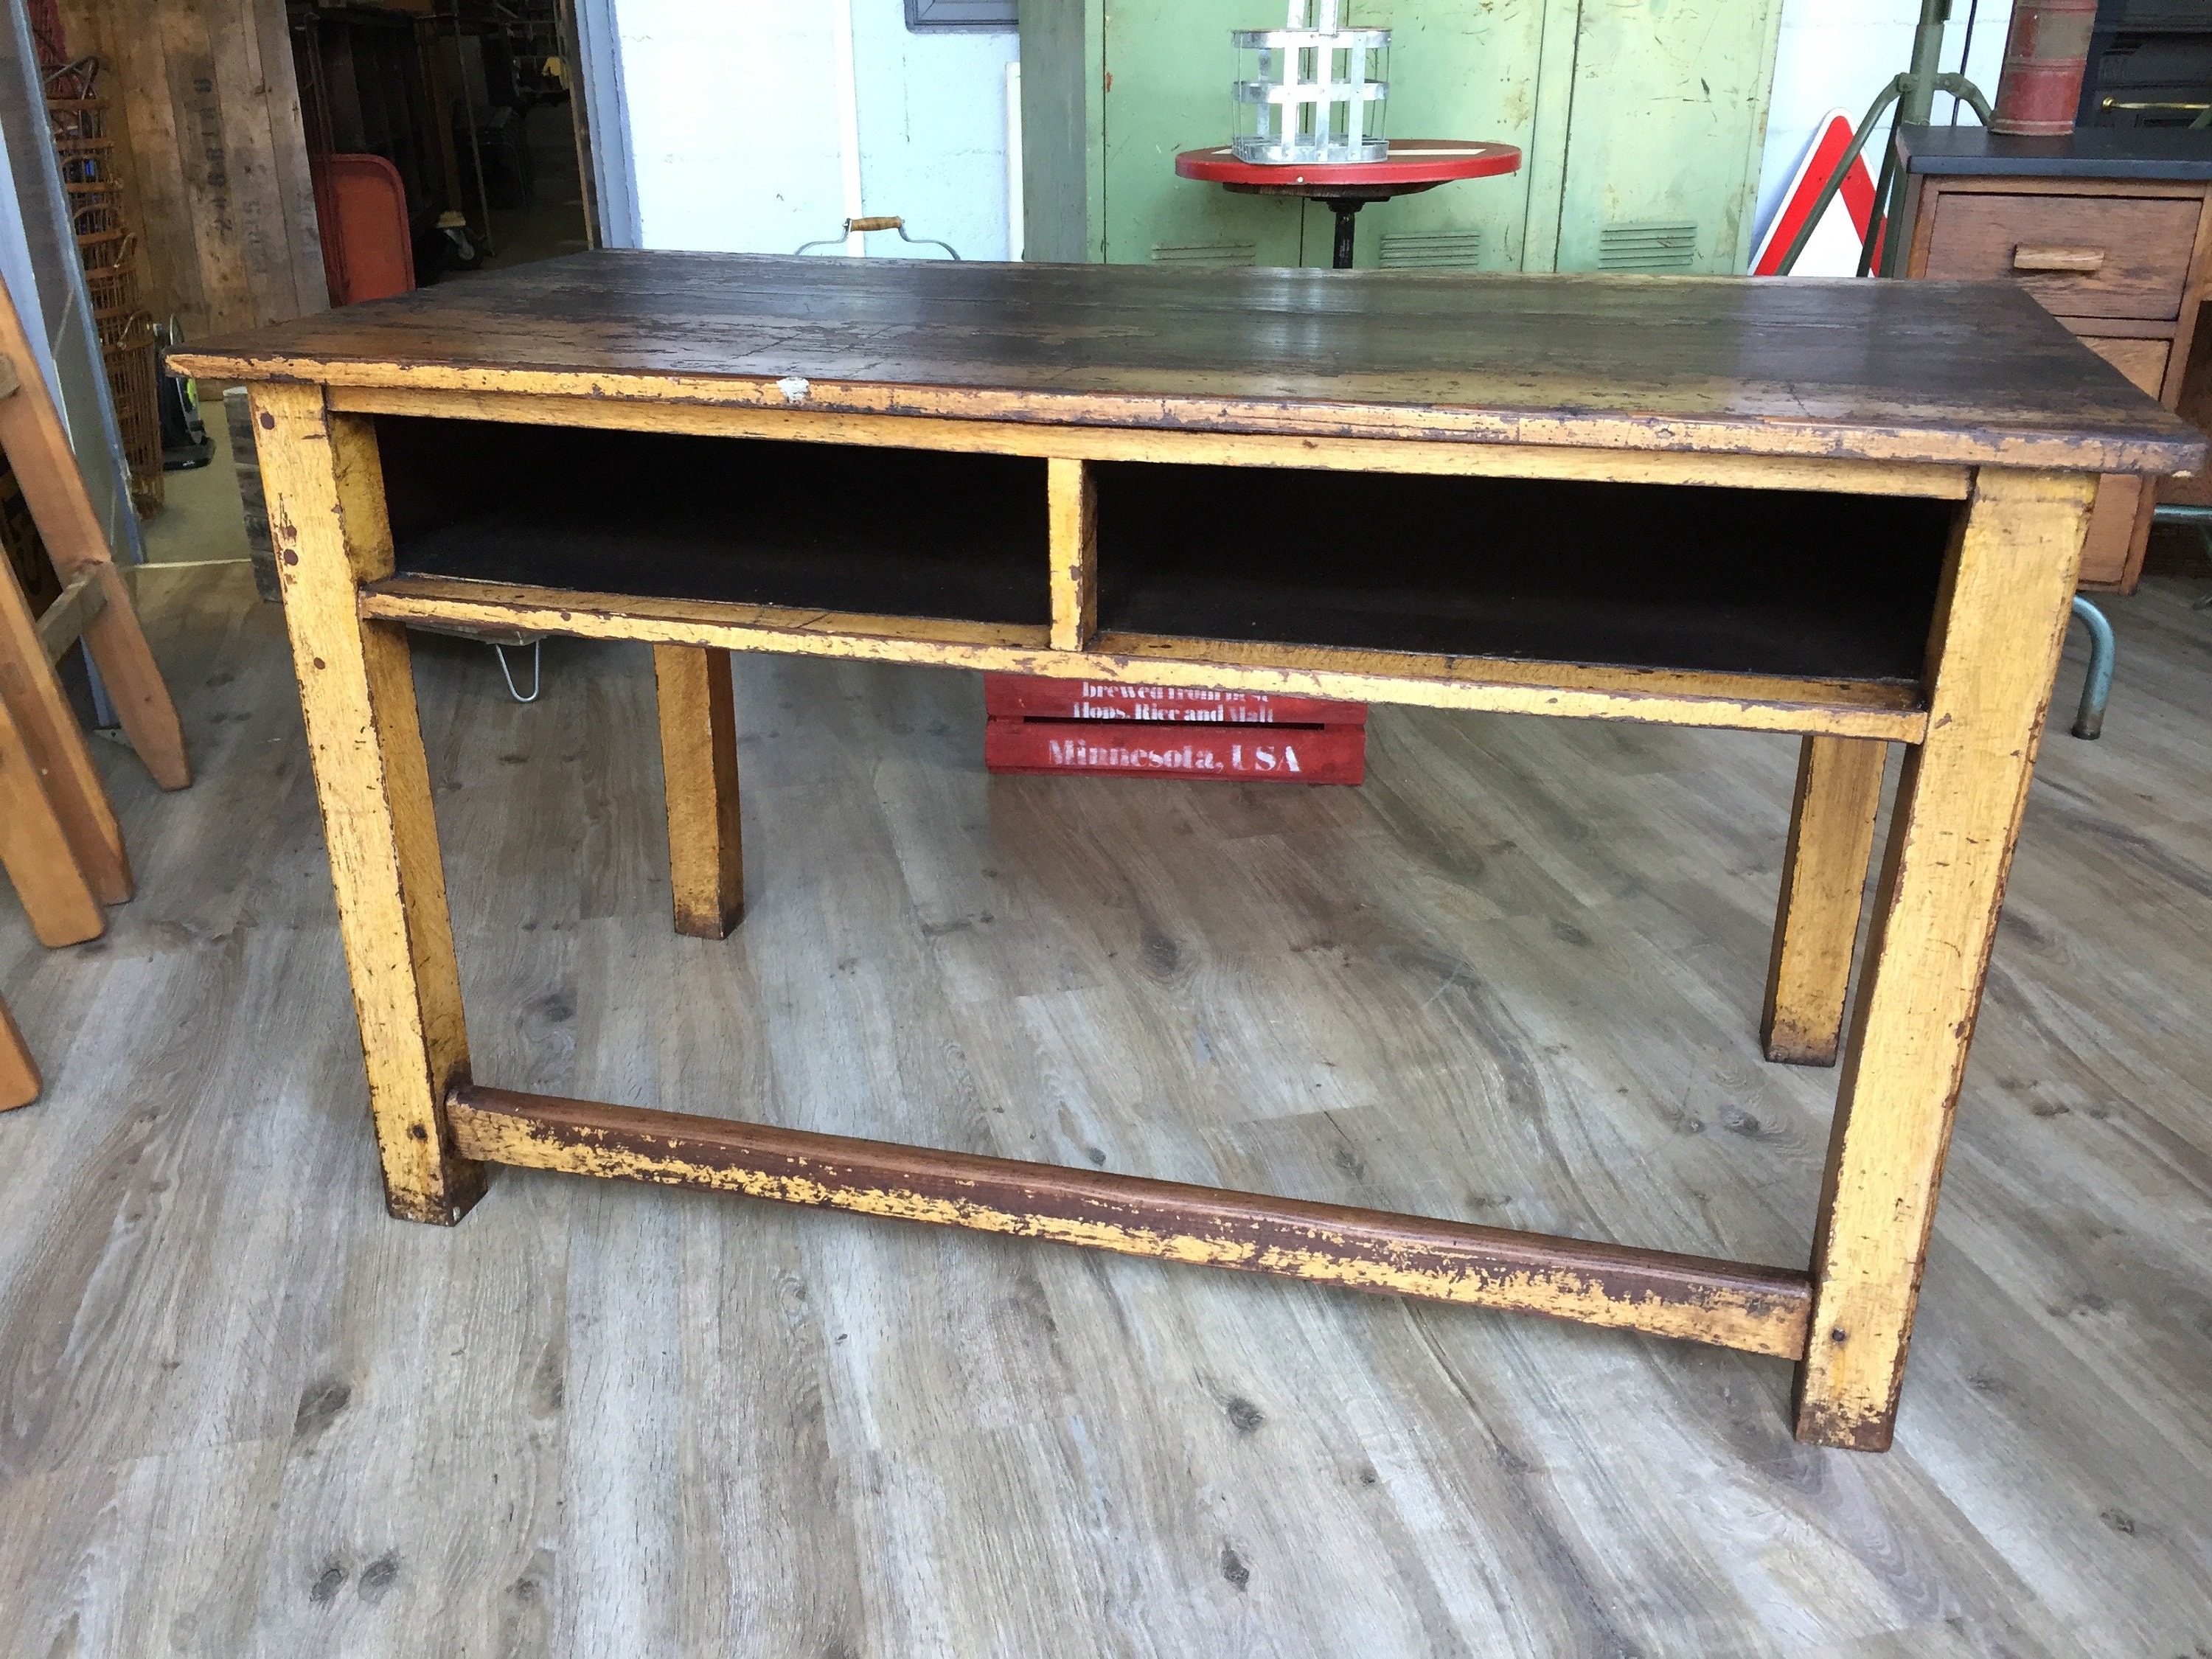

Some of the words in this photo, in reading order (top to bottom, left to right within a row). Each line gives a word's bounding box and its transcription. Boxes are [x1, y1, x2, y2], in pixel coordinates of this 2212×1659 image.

[1082, 681, 1164, 700] brewed
[1134, 703, 1180, 720] Rice
[1183, 704, 1224, 722] and
[1228, 705, 1273, 723] Malt
[1049, 739, 1224, 773] Minnesota,
[1231, 743, 1301, 772] USA
